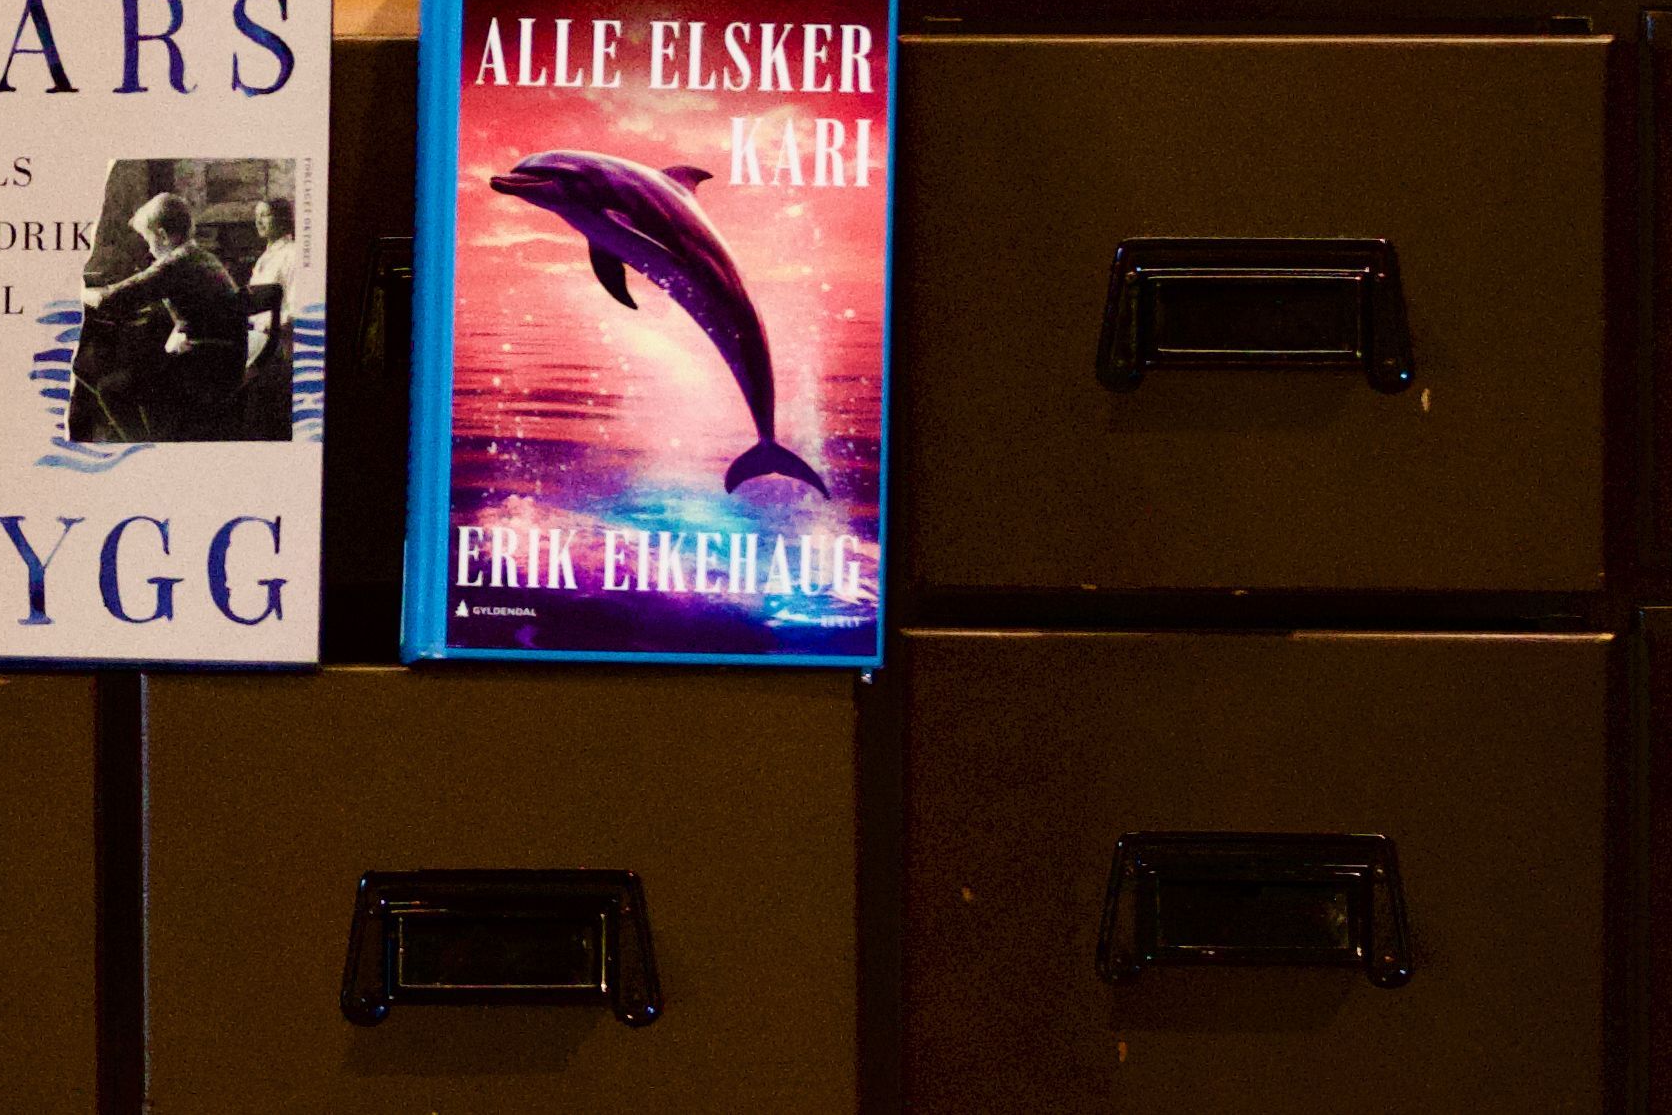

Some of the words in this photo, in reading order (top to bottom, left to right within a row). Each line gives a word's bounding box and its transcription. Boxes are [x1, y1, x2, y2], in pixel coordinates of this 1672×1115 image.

[475, 17, 622, 88] ALLE
[649, 21, 875, 93] ELSKER
[729, 117, 871, 188] KARI
[455, 526, 579, 591] ERIK
[602, 529, 862, 597] EIKEHAUG
[472, 606, 537, 617] GYLDENDAL
